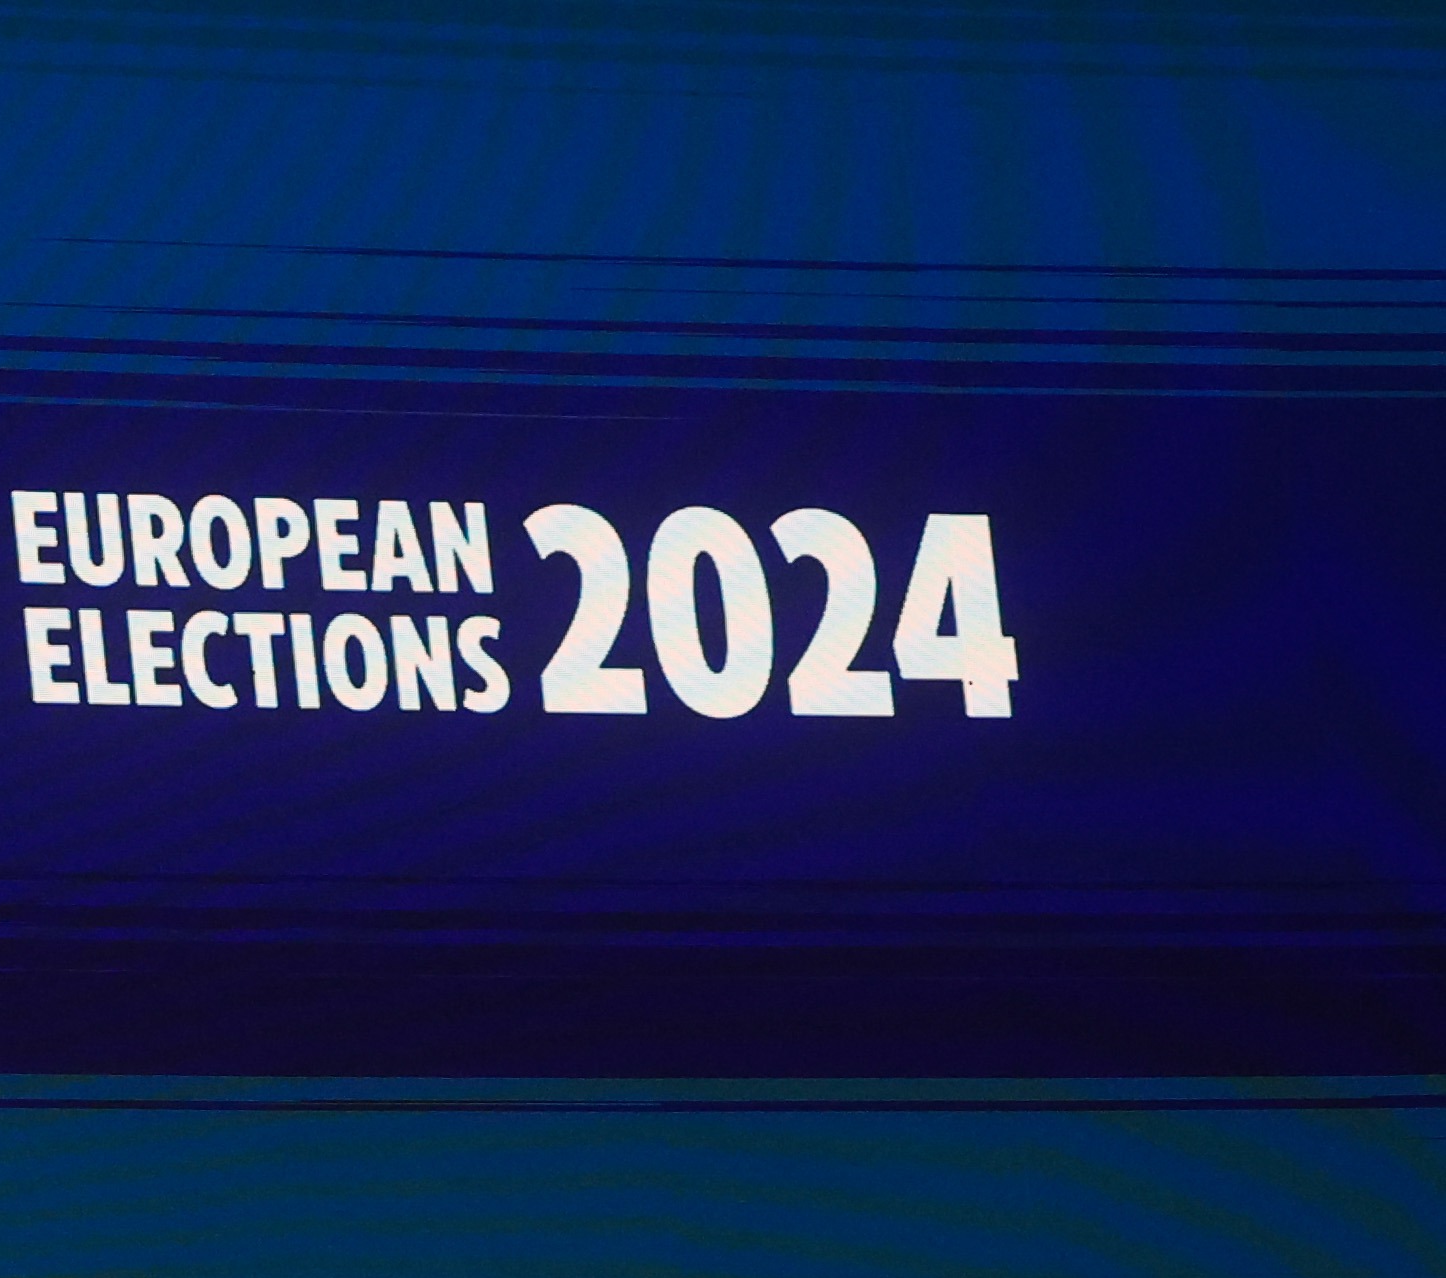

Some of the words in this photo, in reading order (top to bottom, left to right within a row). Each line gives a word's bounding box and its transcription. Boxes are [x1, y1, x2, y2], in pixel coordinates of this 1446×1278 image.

[13, 491, 492, 595] EUROPEAN
[25, 608, 509, 712] ELECTIONS
[527, 505, 1017, 718] 2024
